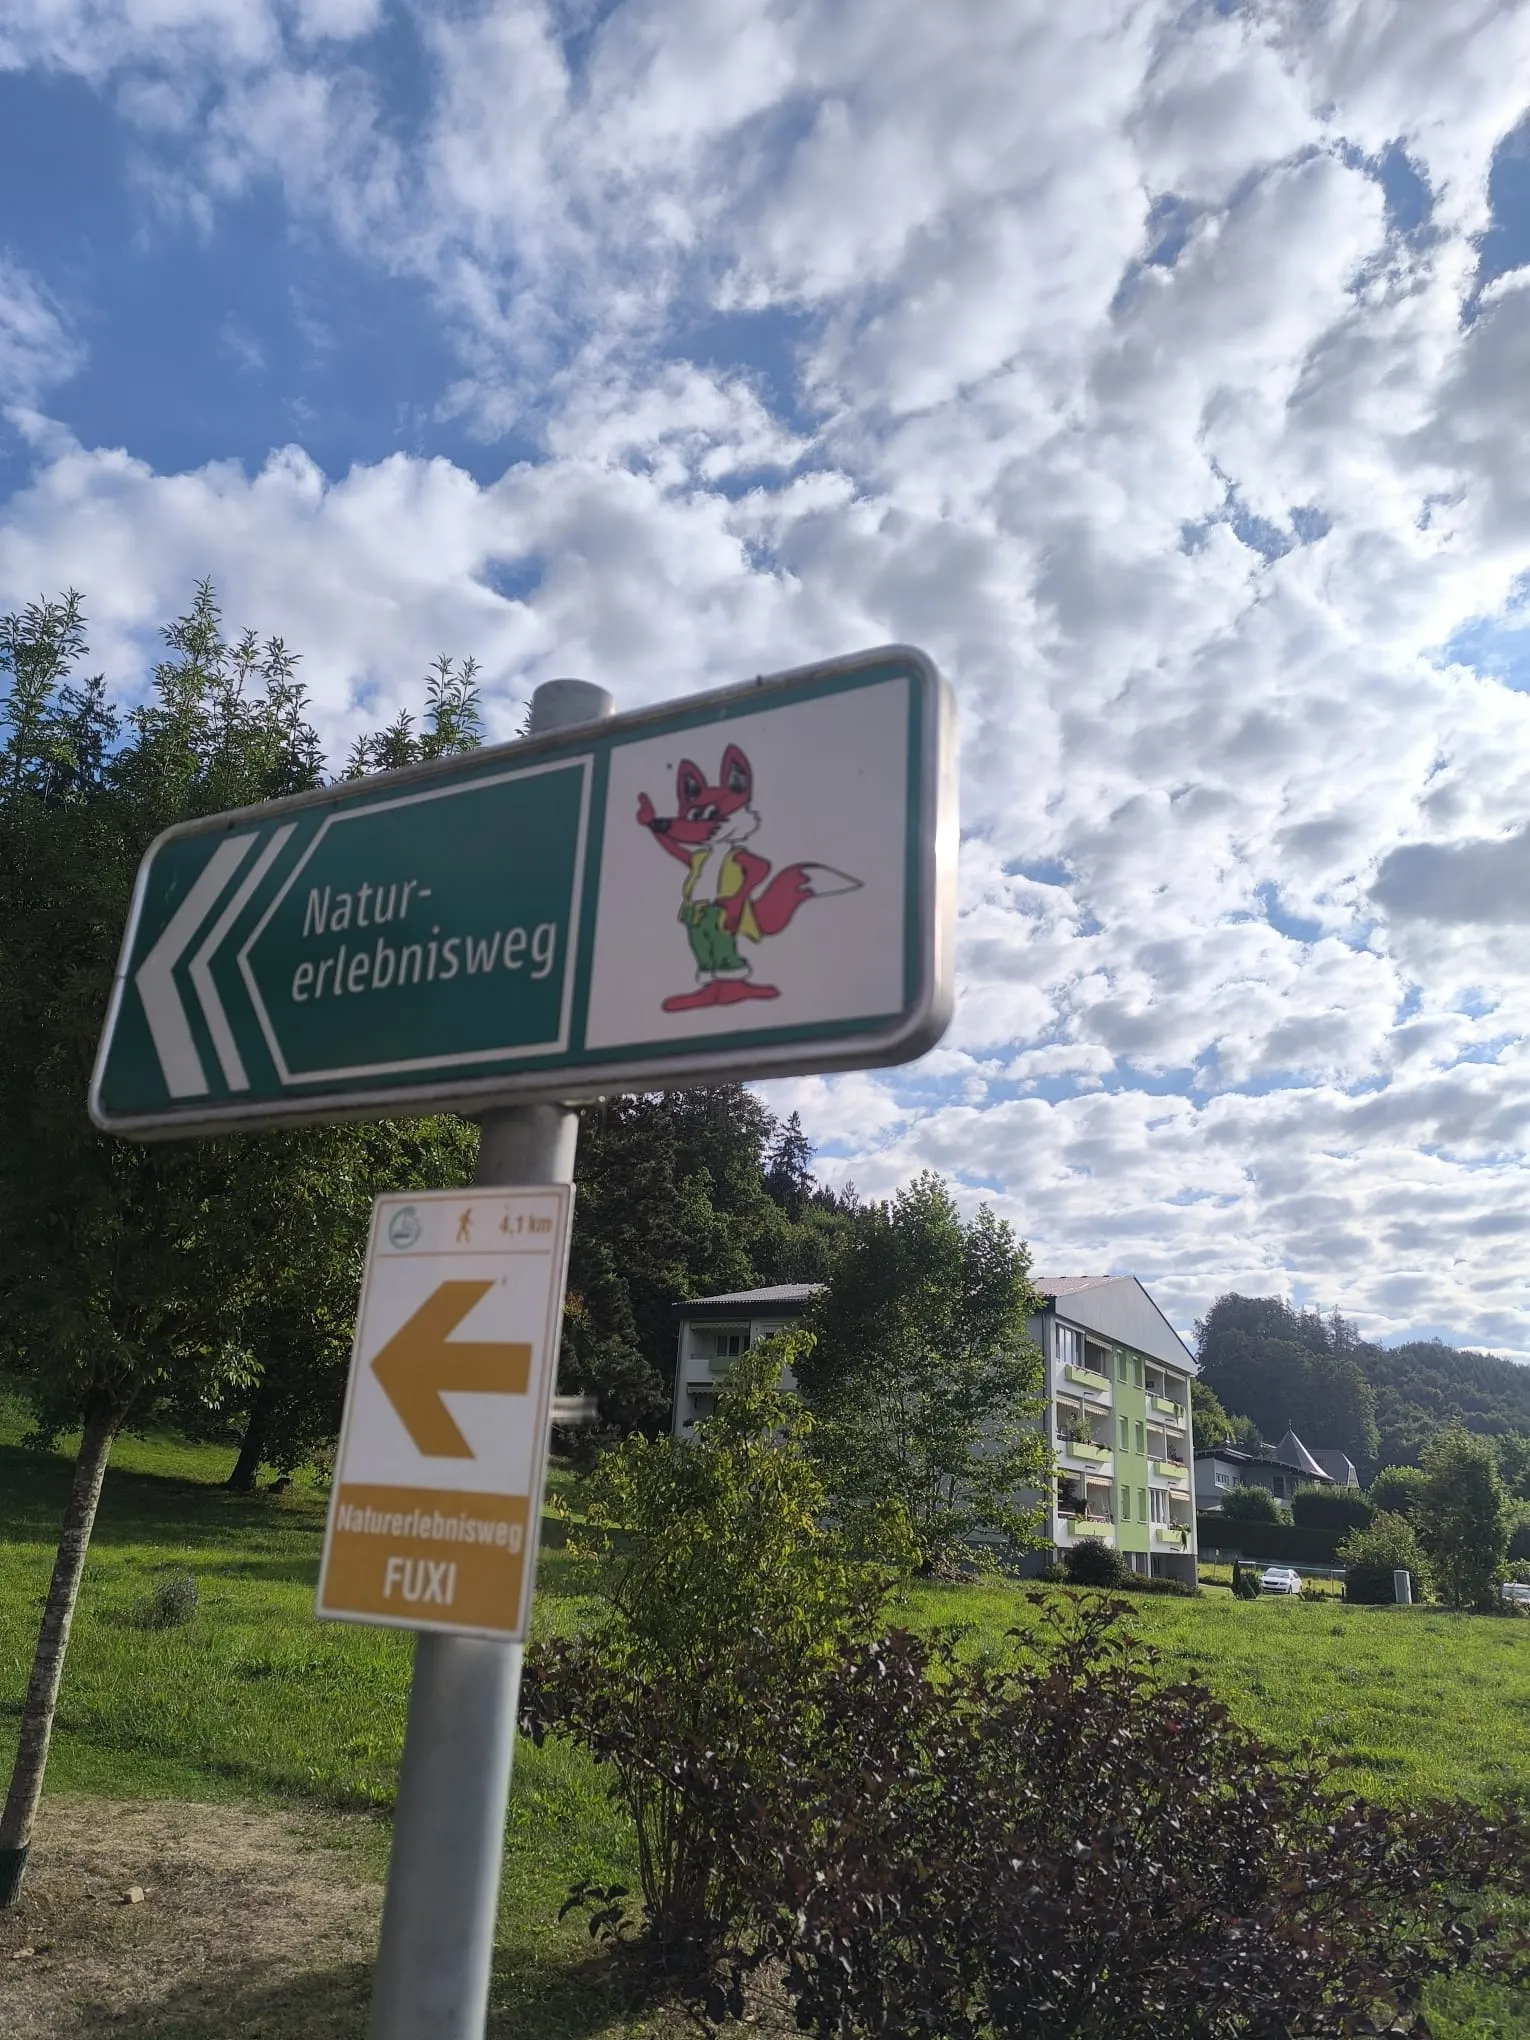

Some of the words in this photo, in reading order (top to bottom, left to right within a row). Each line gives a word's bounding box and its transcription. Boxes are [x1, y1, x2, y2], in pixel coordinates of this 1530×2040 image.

[303, 879, 432, 938] Natur-
[291, 921, 557, 1003] erlebnisweg
[527, 1213, 553, 1234] km
[337, 1503, 524, 1554] Naturerlebnisweg
[382, 1555, 457, 1606] FUXI
